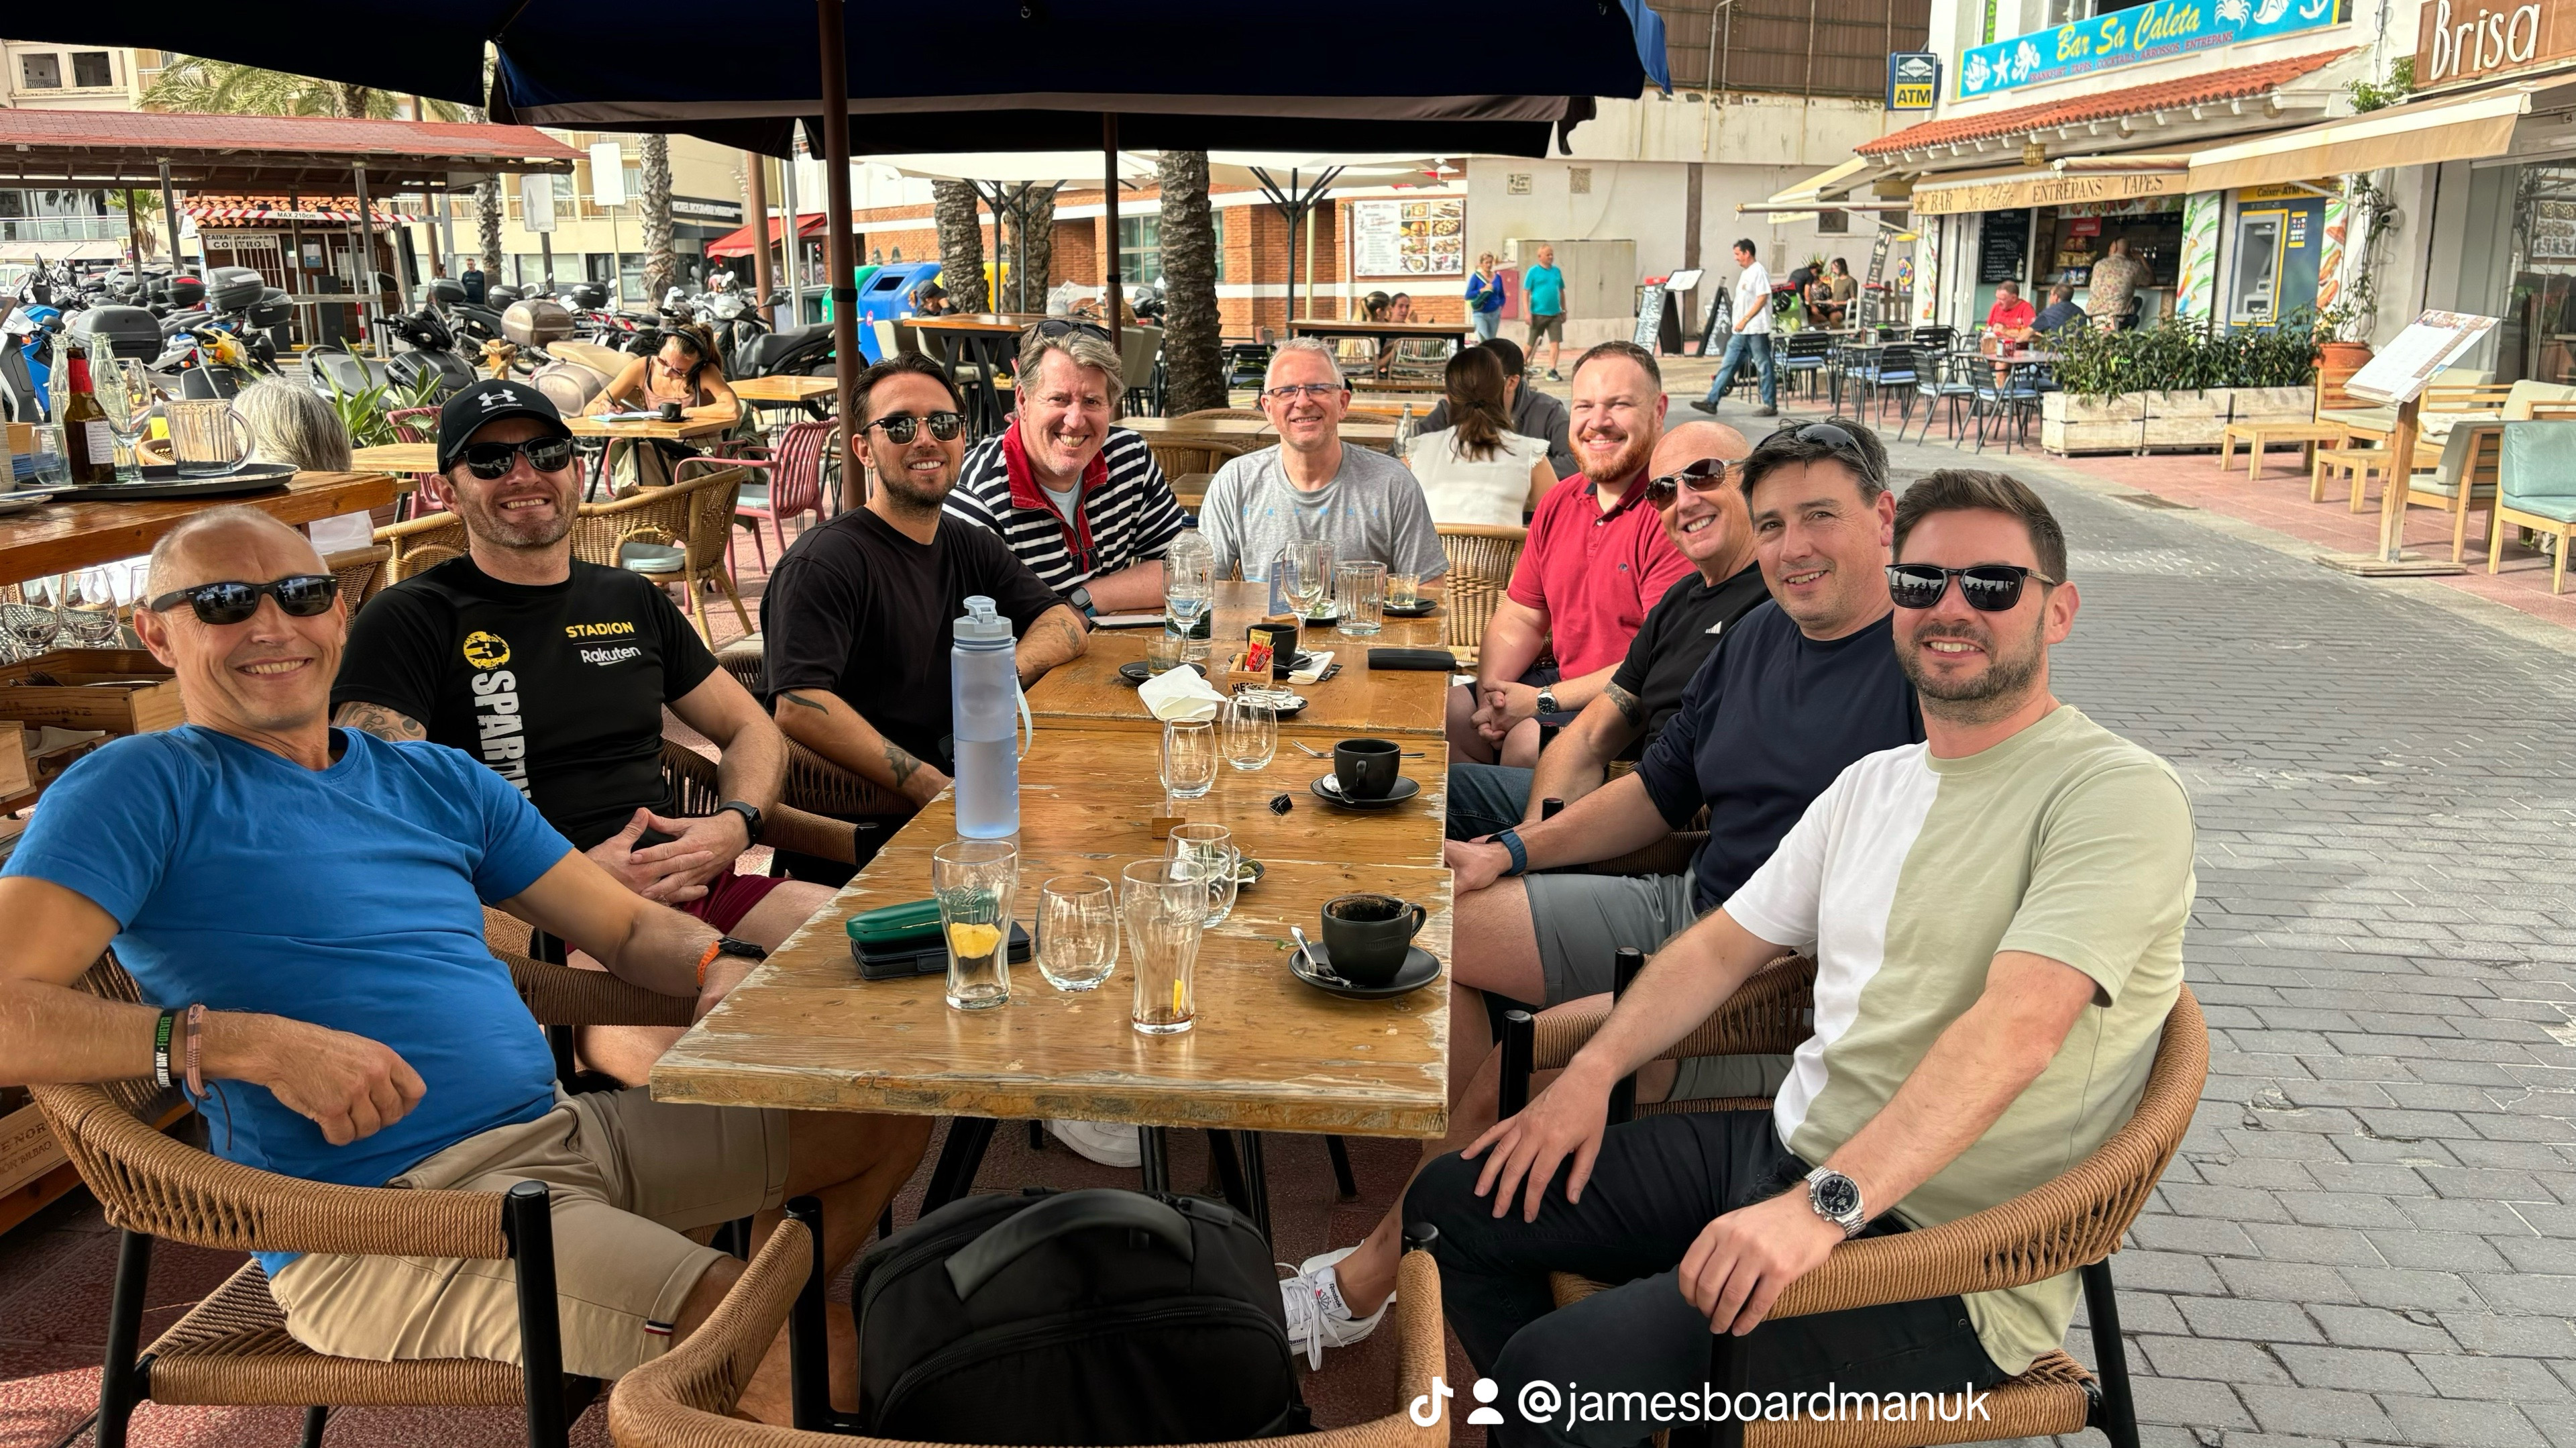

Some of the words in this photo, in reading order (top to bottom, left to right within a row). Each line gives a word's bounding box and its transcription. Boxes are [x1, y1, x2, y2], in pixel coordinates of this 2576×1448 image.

[2057, 25, 2090, 61] Bar
[2096, 17, 2126, 54] Sa
[2133, 3, 2201, 51] Caleta
[2430, 0, 2540, 81] Brisa
[2096, 53, 2136, 70] COCKTAILS
[2140, 43, 2180, 60] ARROSSOS
[2185, 32, 2233, 50] ENTREPANS
[1896, 89, 1931, 103] ATM
[1931, 193, 1953, 211] BAR
[2033, 178, 2103, 203] ENTREPANS
[2122, 174, 2163, 195] TAPES
[566, 621, 635, 638] STADION
[580, 646, 642, 664] Rakuten
[156, 1051, 168, 1067] DAY
[14, 1121, 48, 1145] NOR
[21, 1141, 52, 1164] BILBAO
